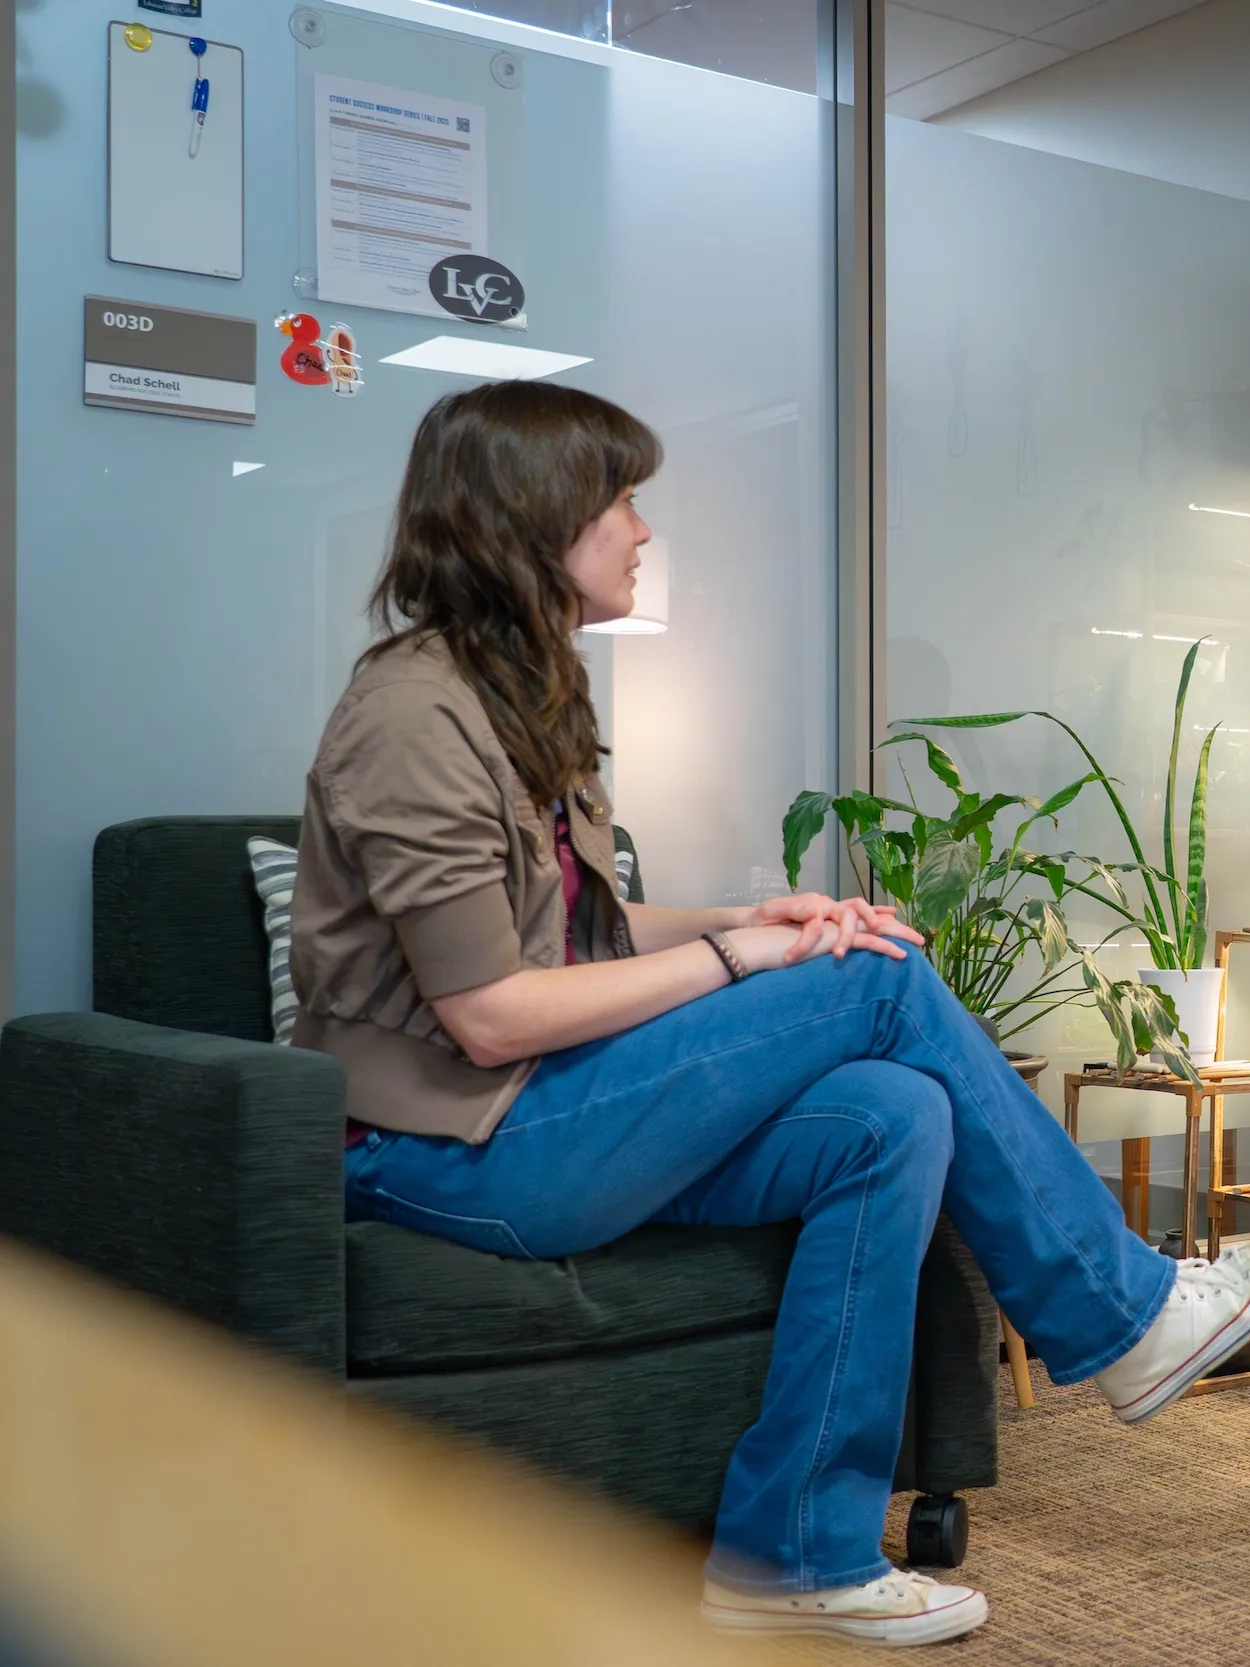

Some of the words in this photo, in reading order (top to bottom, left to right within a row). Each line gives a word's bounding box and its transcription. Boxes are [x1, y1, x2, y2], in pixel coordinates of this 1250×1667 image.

[329, 95, 351, 105] STUDENT
[353, 100, 375, 110] SUCCESS
[424, 114, 436, 123] FALL
[103, 311, 154, 332] 003D
[109, 373, 141, 386] Chad
[143, 377, 181, 391] Schell
